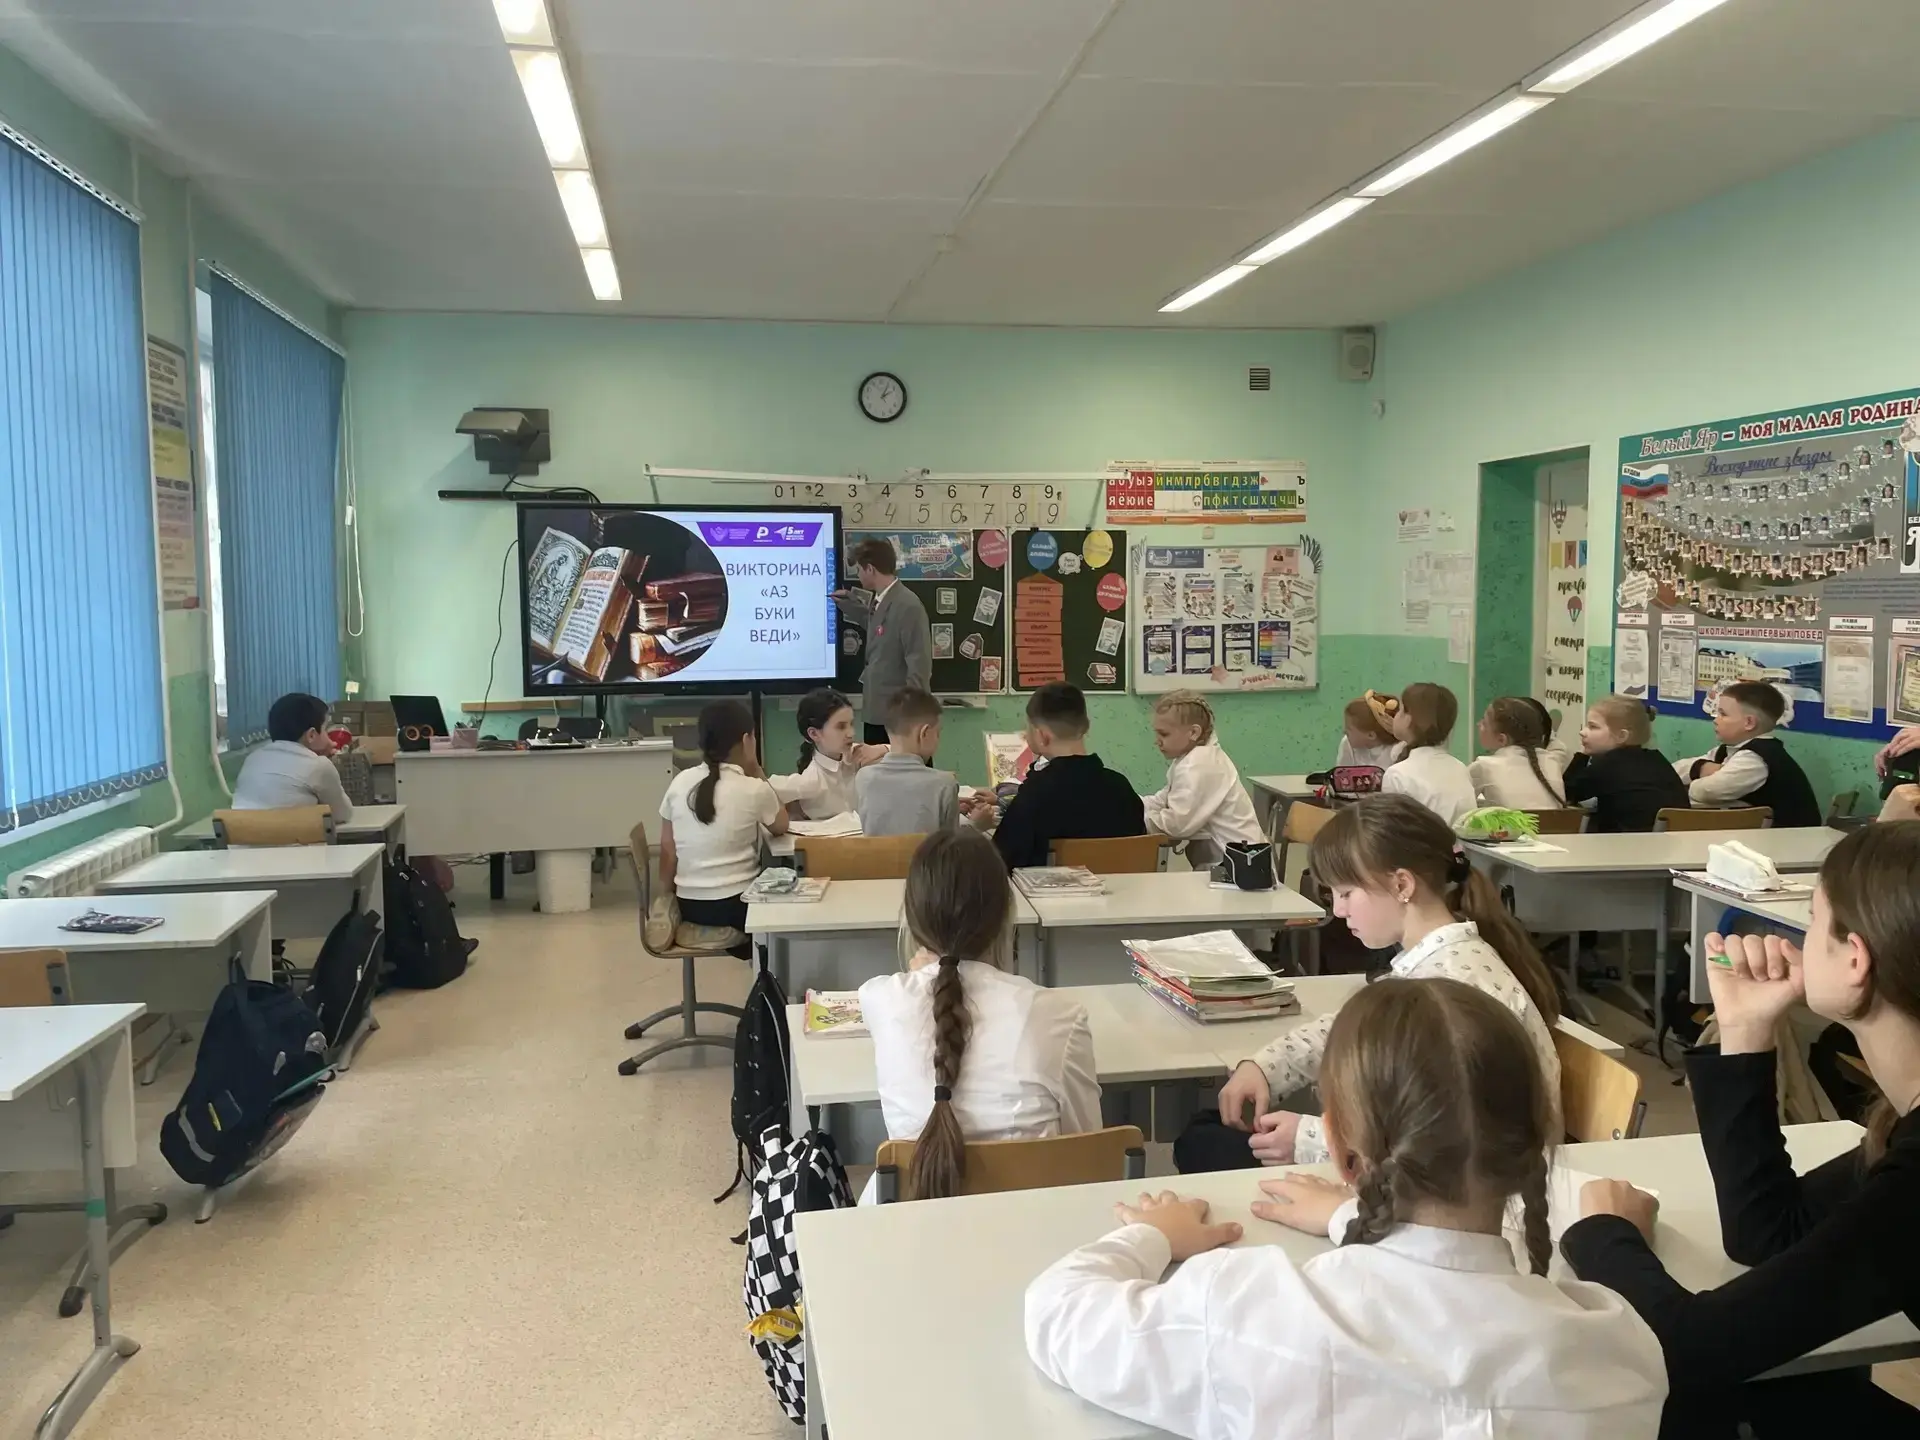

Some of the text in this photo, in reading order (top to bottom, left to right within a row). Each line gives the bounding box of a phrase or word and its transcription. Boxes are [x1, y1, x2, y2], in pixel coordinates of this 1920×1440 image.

[1641, 430, 1691, 457] Белый
[1693, 428, 1718, 454] Яр
[1741, 423, 1774, 440] МОЯ
[1779, 410, 1843, 433] МАЛАЯ
[774, 483, 1053, 498] 0 1 2 3 4 5 6 7 8 9
[851, 502, 1059, 524] 3 4 5 6 7 8 9
[787, 526, 794, 534] 5
[726, 563, 822, 576] ВИКТОРИНА
[761, 585, 789, 598] «АЗ
[755, 607, 795, 620] БУКИ
[750, 629, 801, 644] ВЕДИ»
[1699, 627, 1823, 640] ШКОЛА НАШИХ ПЕРВЫХ ПОБЕД
